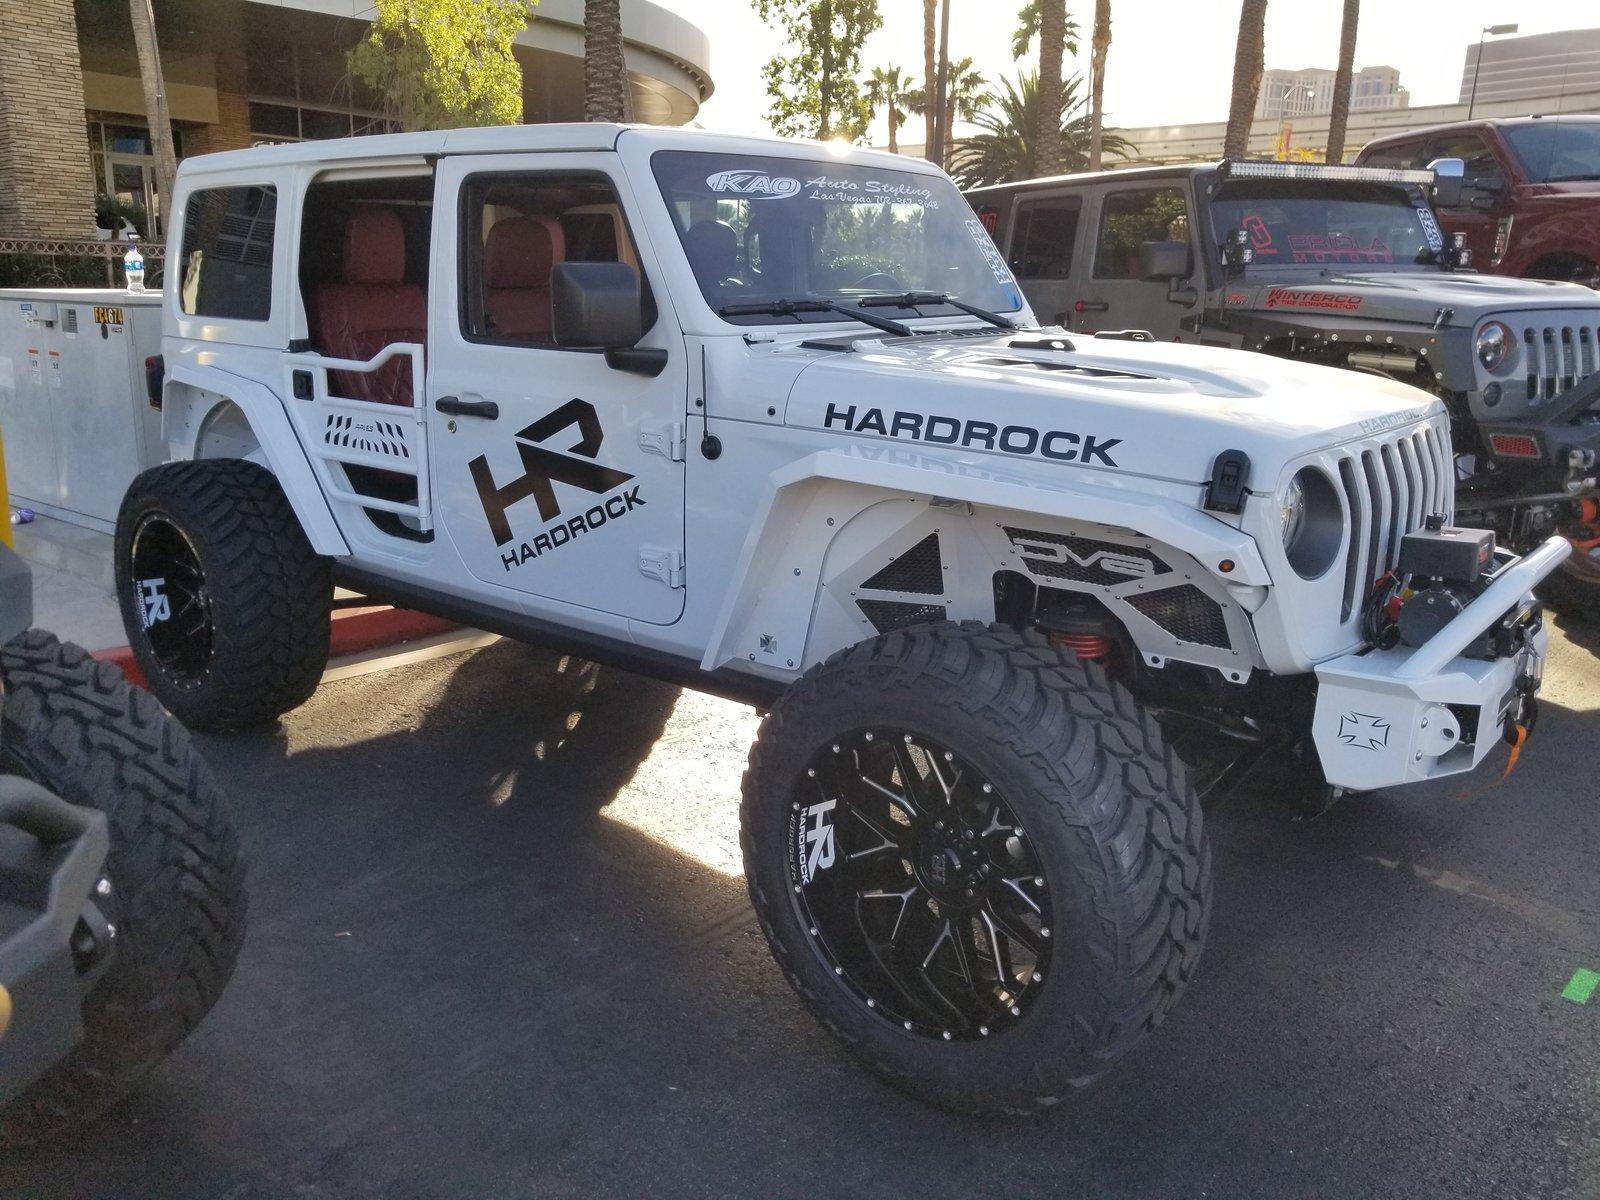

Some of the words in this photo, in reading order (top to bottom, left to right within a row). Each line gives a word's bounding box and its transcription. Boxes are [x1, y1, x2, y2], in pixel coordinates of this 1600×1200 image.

[713, 174, 799, 194] KAO
[804, 175, 859, 190] Auto
[864, 180, 933, 199] Styling
[809, 189, 833, 200] Las
[835, 191, 872, 205] Vegas
[823, 402, 1124, 468] HARDROCK
[1360, 406, 1428, 433] HARDROC
[501, 485, 647, 572] HARDROCK
[136, 580, 150, 628] HARDROCK
[798, 806, 810, 886] HARDROCK
